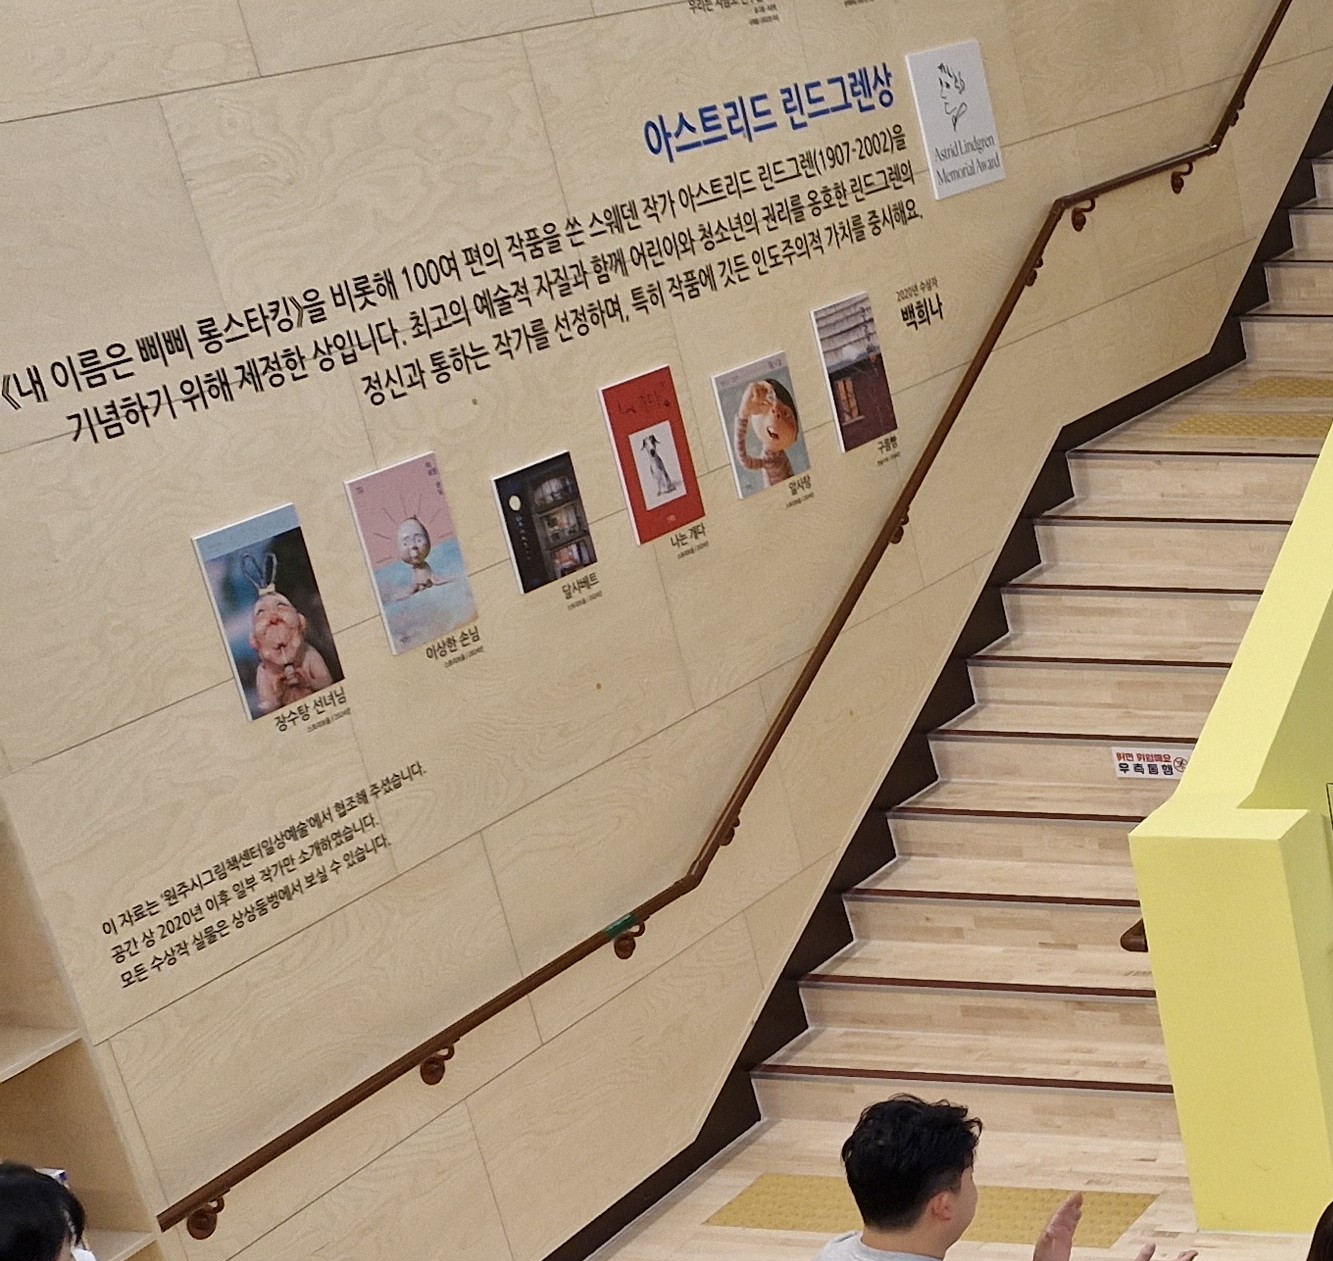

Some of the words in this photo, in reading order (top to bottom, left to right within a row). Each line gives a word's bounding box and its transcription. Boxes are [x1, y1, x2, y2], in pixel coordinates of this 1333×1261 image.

[645, 94, 777, 162] 아스트리드
[780, 62, 894, 131] 린드그렌상
[51, 343, 134, 392] 이름은
[136, 325, 194, 367] 삐삐
[197, 289, 327, 354] 롱스타킹》을
[331, 268, 399, 312] 비롯해
[402, 250, 462, 291] 100여
[462, 238, 504, 277] 편의
[505, 222, 562, 262] 작품을
[565, 216, 585, 247] 쓴
[589, 200, 642, 236] 스웨덴
[642, 190, 677, 225] 작가
[679, 170, 757, 209] 아스트리드
[758, 123, 908, 192] 린드그렌(1907-2002)을
[66, 384, 177, 443] 기념하기
[180, 367, 234, 412] 위해
[235, 345, 308, 392] 제정한
[312, 317, 407, 371] 상입니다.
[409, 295, 472, 339] 최고의
[473, 277, 532, 320] 예술적
[534, 259, 589, 300] 자질과
[590, 248, 629, 285] 함께
[630, 227, 697, 270] 어린이와
[699, 210, 761, 251] 청소년의
[763, 194, 806, 232] 권리를
[807, 180, 849, 217] 옹호한
[849, 160, 916, 203] 린드그렌의
[361, 358, 427, 405] 정신과
[430, 342, 491, 384] 통하는
[492, 319, 550, 360] 작가를
[554, 294, 630, 343] 선정하며,
[630, 279, 666, 315] 특히
[667, 263, 717, 302] 작품에
[717, 253, 750, 286] 깃든
[751, 235, 824, 276] 인도주의적
[825, 215, 866, 249] 가치를
[900, 293, 943, 331] 백희나
[274, 704, 310, 732] 장수탕
[313, 687, 347, 716] 선녀님
[426, 637, 457, 661] 이상한
[459, 626, 480, 647] 손님
[103, 918, 118, 936] 이
[120, 898, 160, 928] 자료는
[334, 789, 369, 819] 협조해
[111, 938, 140, 964] 공간
[142, 930, 156, 947] 상
[159, 905, 204, 939] 2020년
[205, 890, 231, 914] 이후
[232, 878, 259, 901] 일부
[260, 855, 296, 887] 작가만
[298, 812, 379, 864] 소개하였습니다.
[120, 964, 149, 988] 모든
[150, 941, 191, 971] 수상작
[192, 920, 229, 951] 실물은
[305, 865, 329, 889] 보실
[330, 857, 344, 876] 수
[343, 832, 392, 868] 있습니다.
